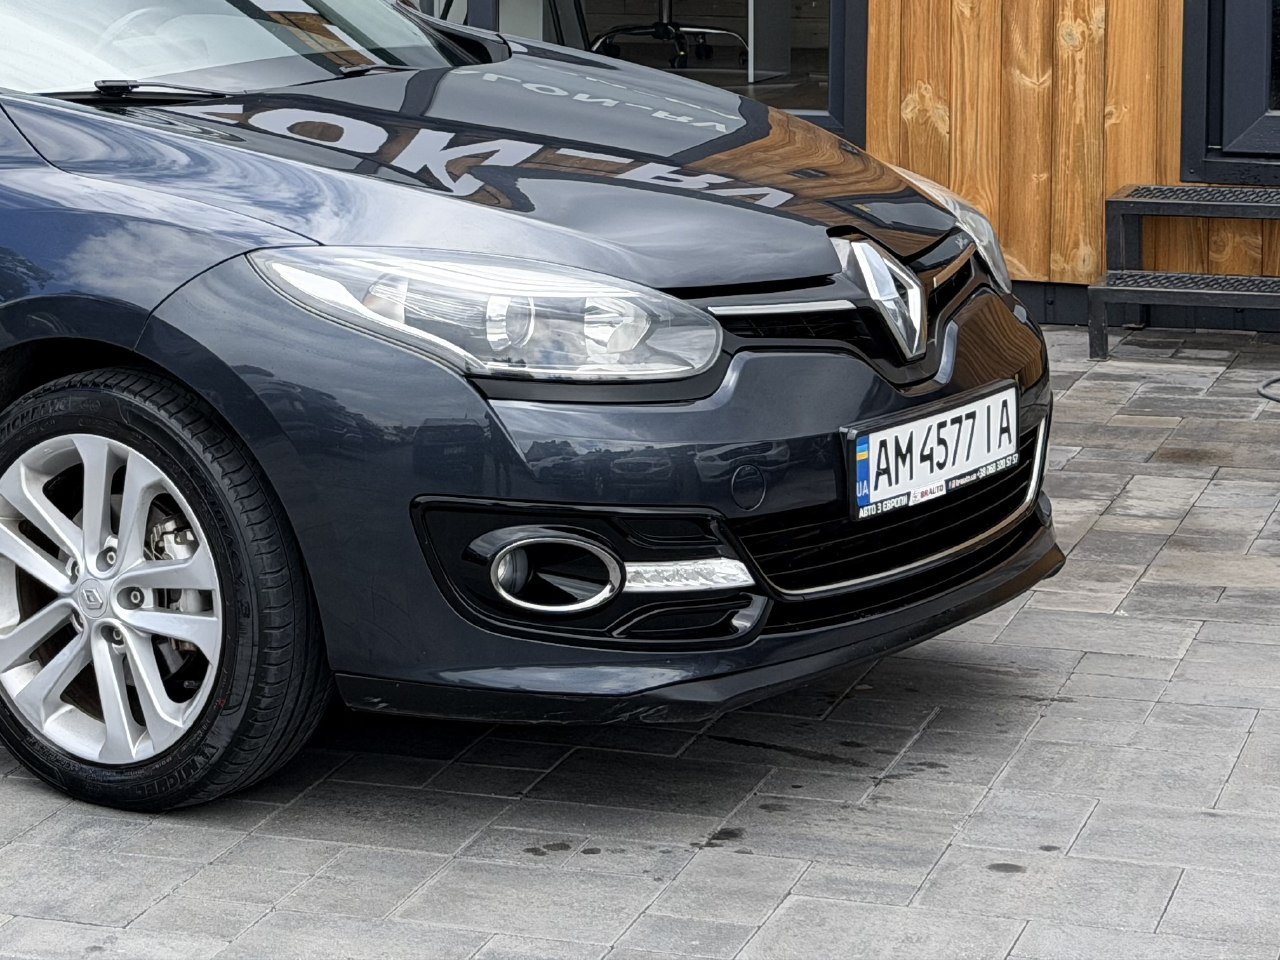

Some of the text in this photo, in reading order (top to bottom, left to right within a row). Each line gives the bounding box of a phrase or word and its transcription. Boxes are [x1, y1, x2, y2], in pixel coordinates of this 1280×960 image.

[874, 398, 1013, 491] AM 4577 IA
[856, 480, 869, 497] UA
